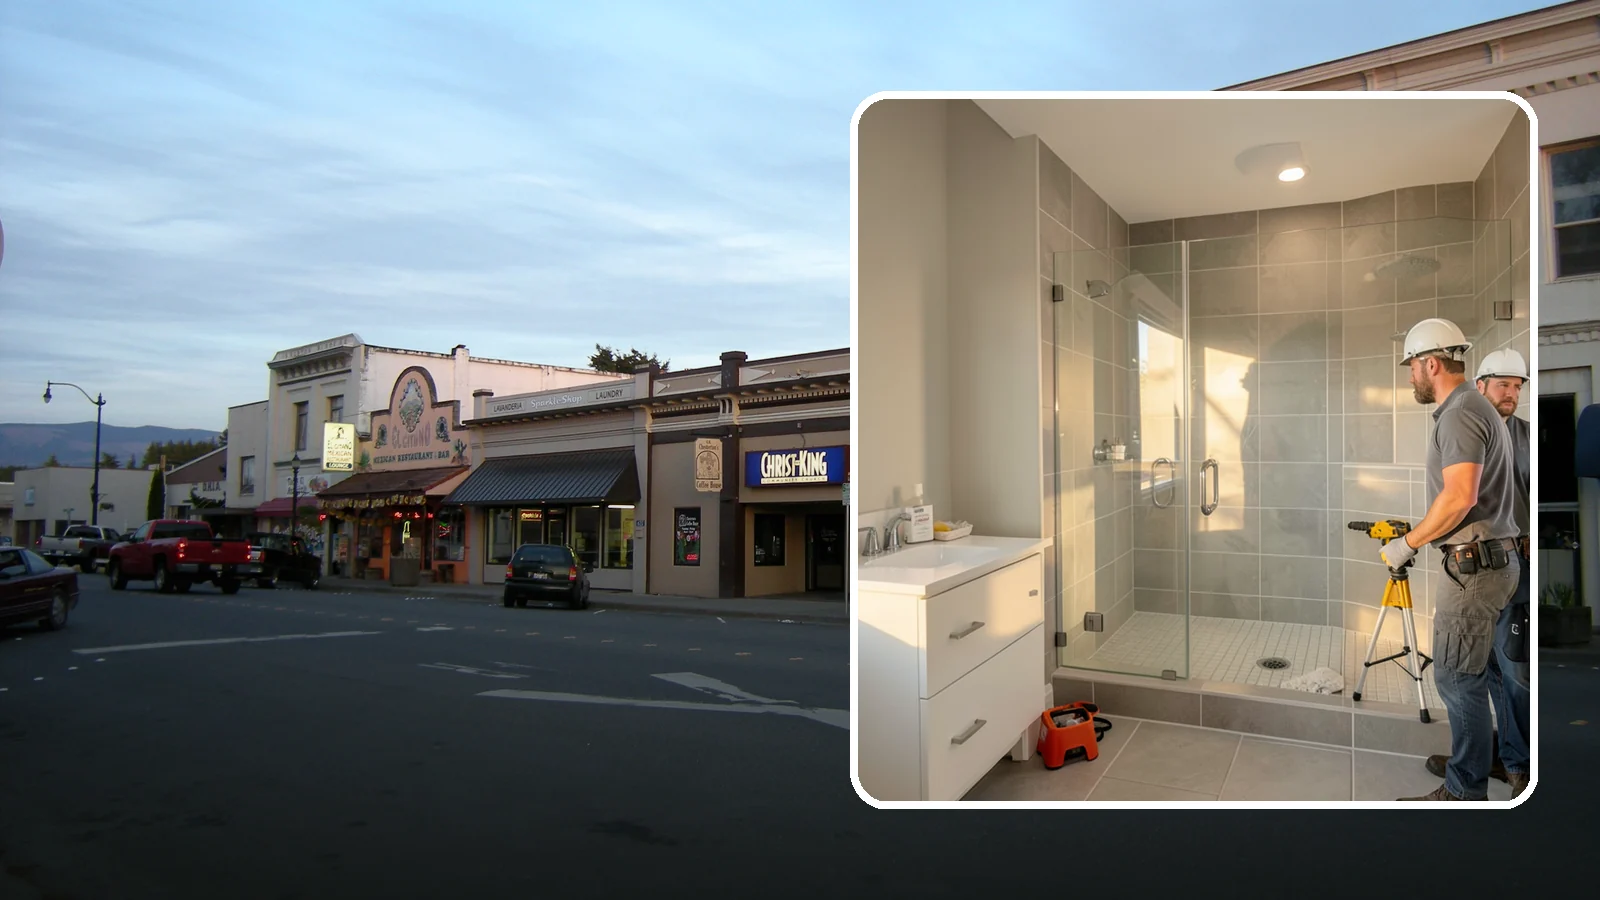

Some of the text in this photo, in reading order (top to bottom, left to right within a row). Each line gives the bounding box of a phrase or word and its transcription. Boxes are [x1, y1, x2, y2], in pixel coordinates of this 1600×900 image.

[595, 389, 623, 400] LAUNDRY
[493, 402, 522, 413] LAVANDERIA
[531, 394, 583, 409] Sparkle Shop
[373, 455, 396, 464] MEXICAN
[397, 451, 433, 463] RESTAURANT
[438, 450, 450, 459] BAR
[761, 450, 827, 477] CHRIST KING
[696, 480, 722, 489] Coffee House
